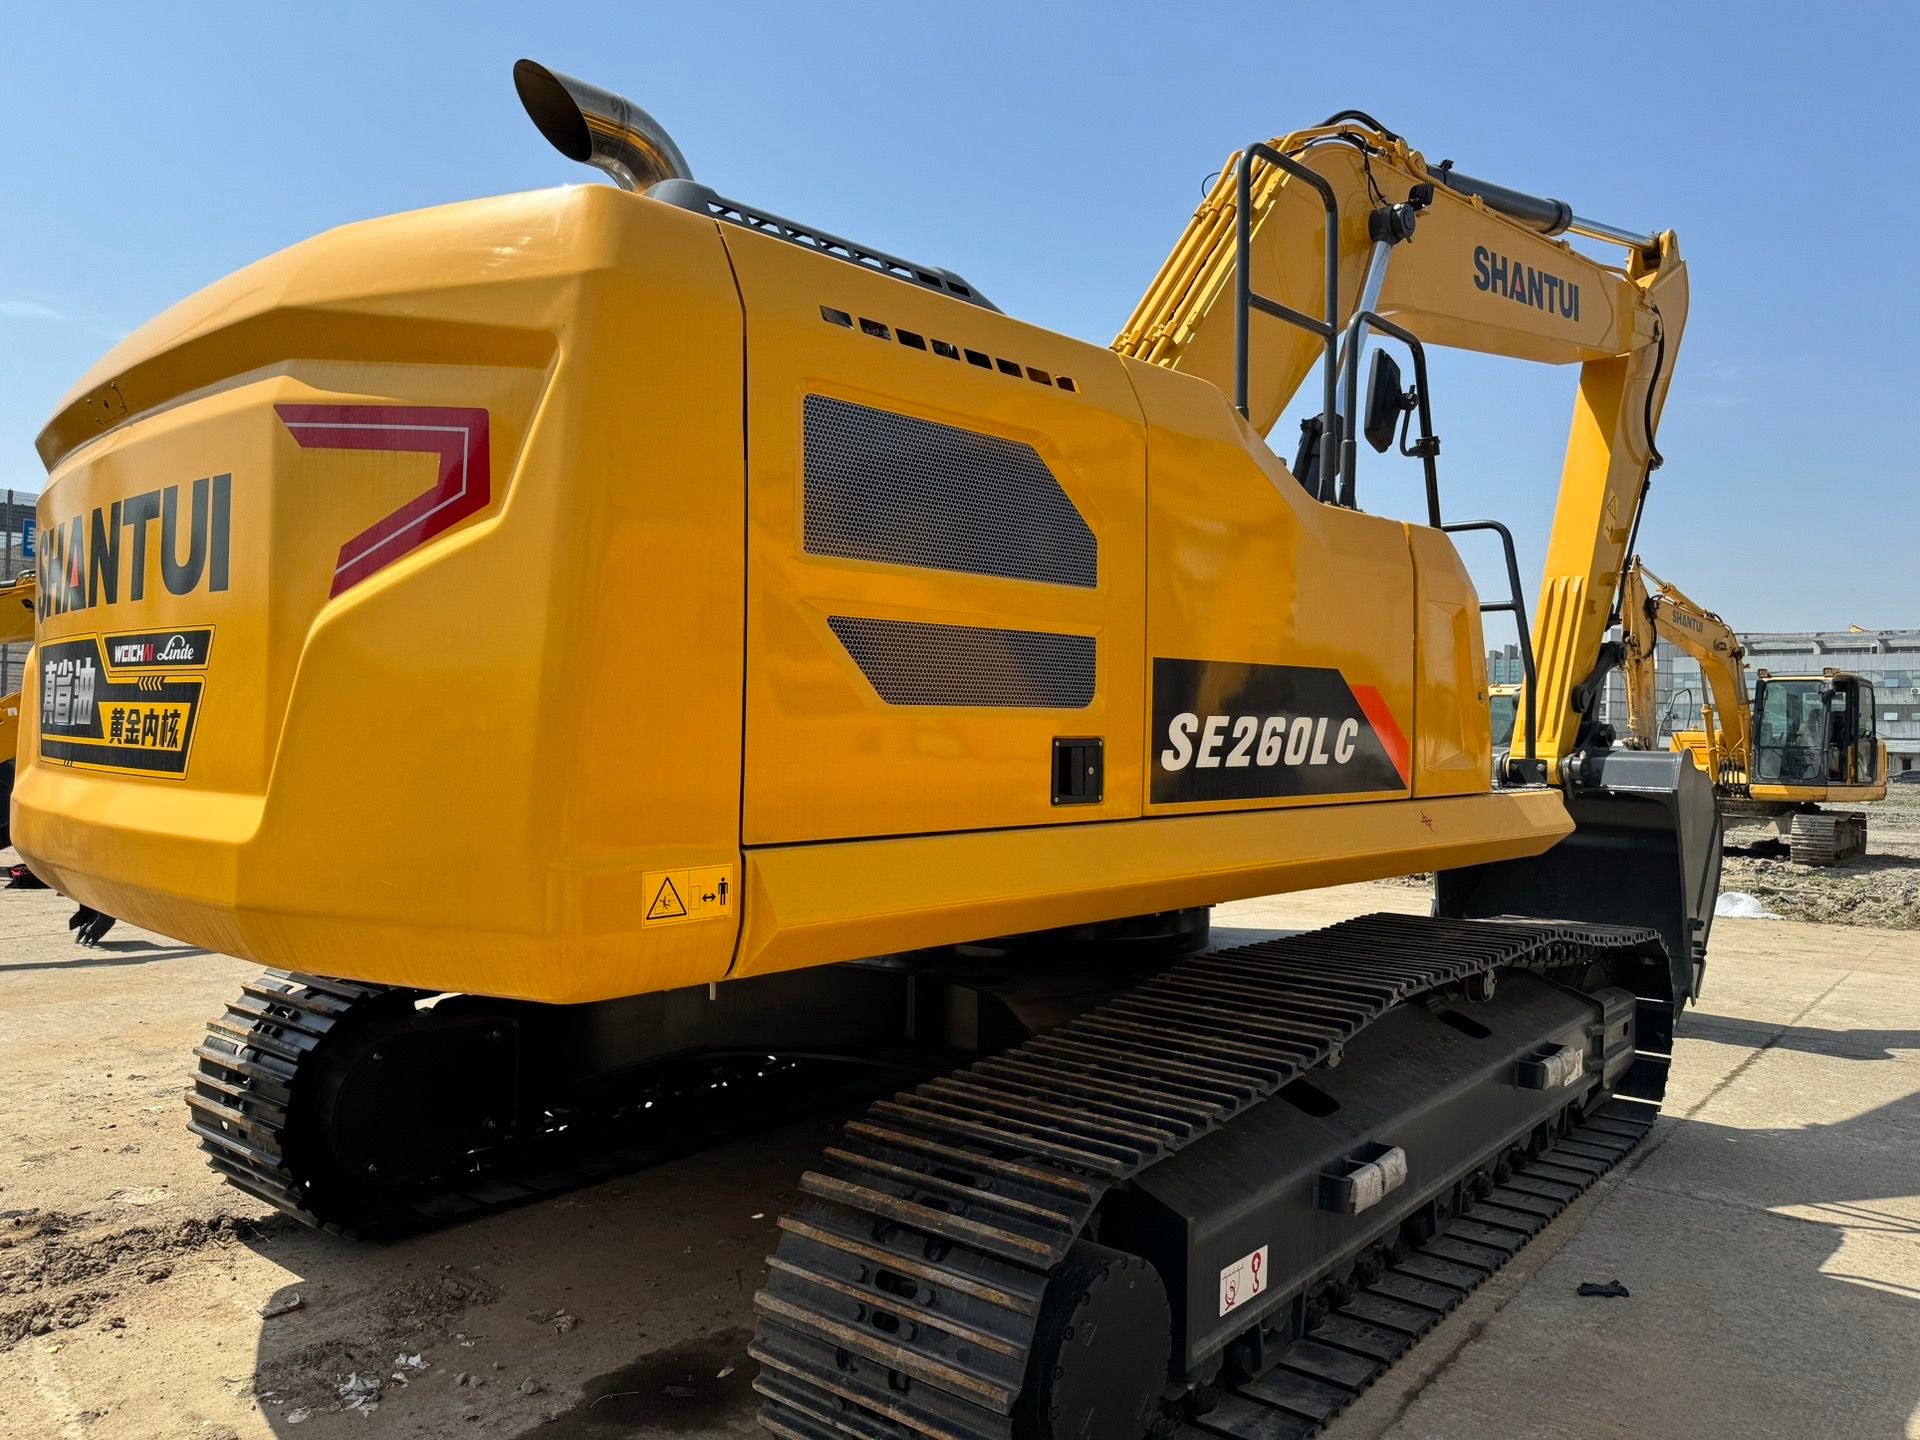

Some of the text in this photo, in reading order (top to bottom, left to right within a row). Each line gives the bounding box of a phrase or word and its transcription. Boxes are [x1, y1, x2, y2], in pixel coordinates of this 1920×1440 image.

[1473, 245, 1580, 322] SHANTUI
[37, 473, 232, 625] SHANTUI
[157, 634, 194, 661] Linde
[1672, 609, 1704, 634] SHANTUI
[42, 657, 96, 726] 真省油
[109, 707, 181, 748] 黄金内核
[1160, 712, 1359, 772] SE260LC
